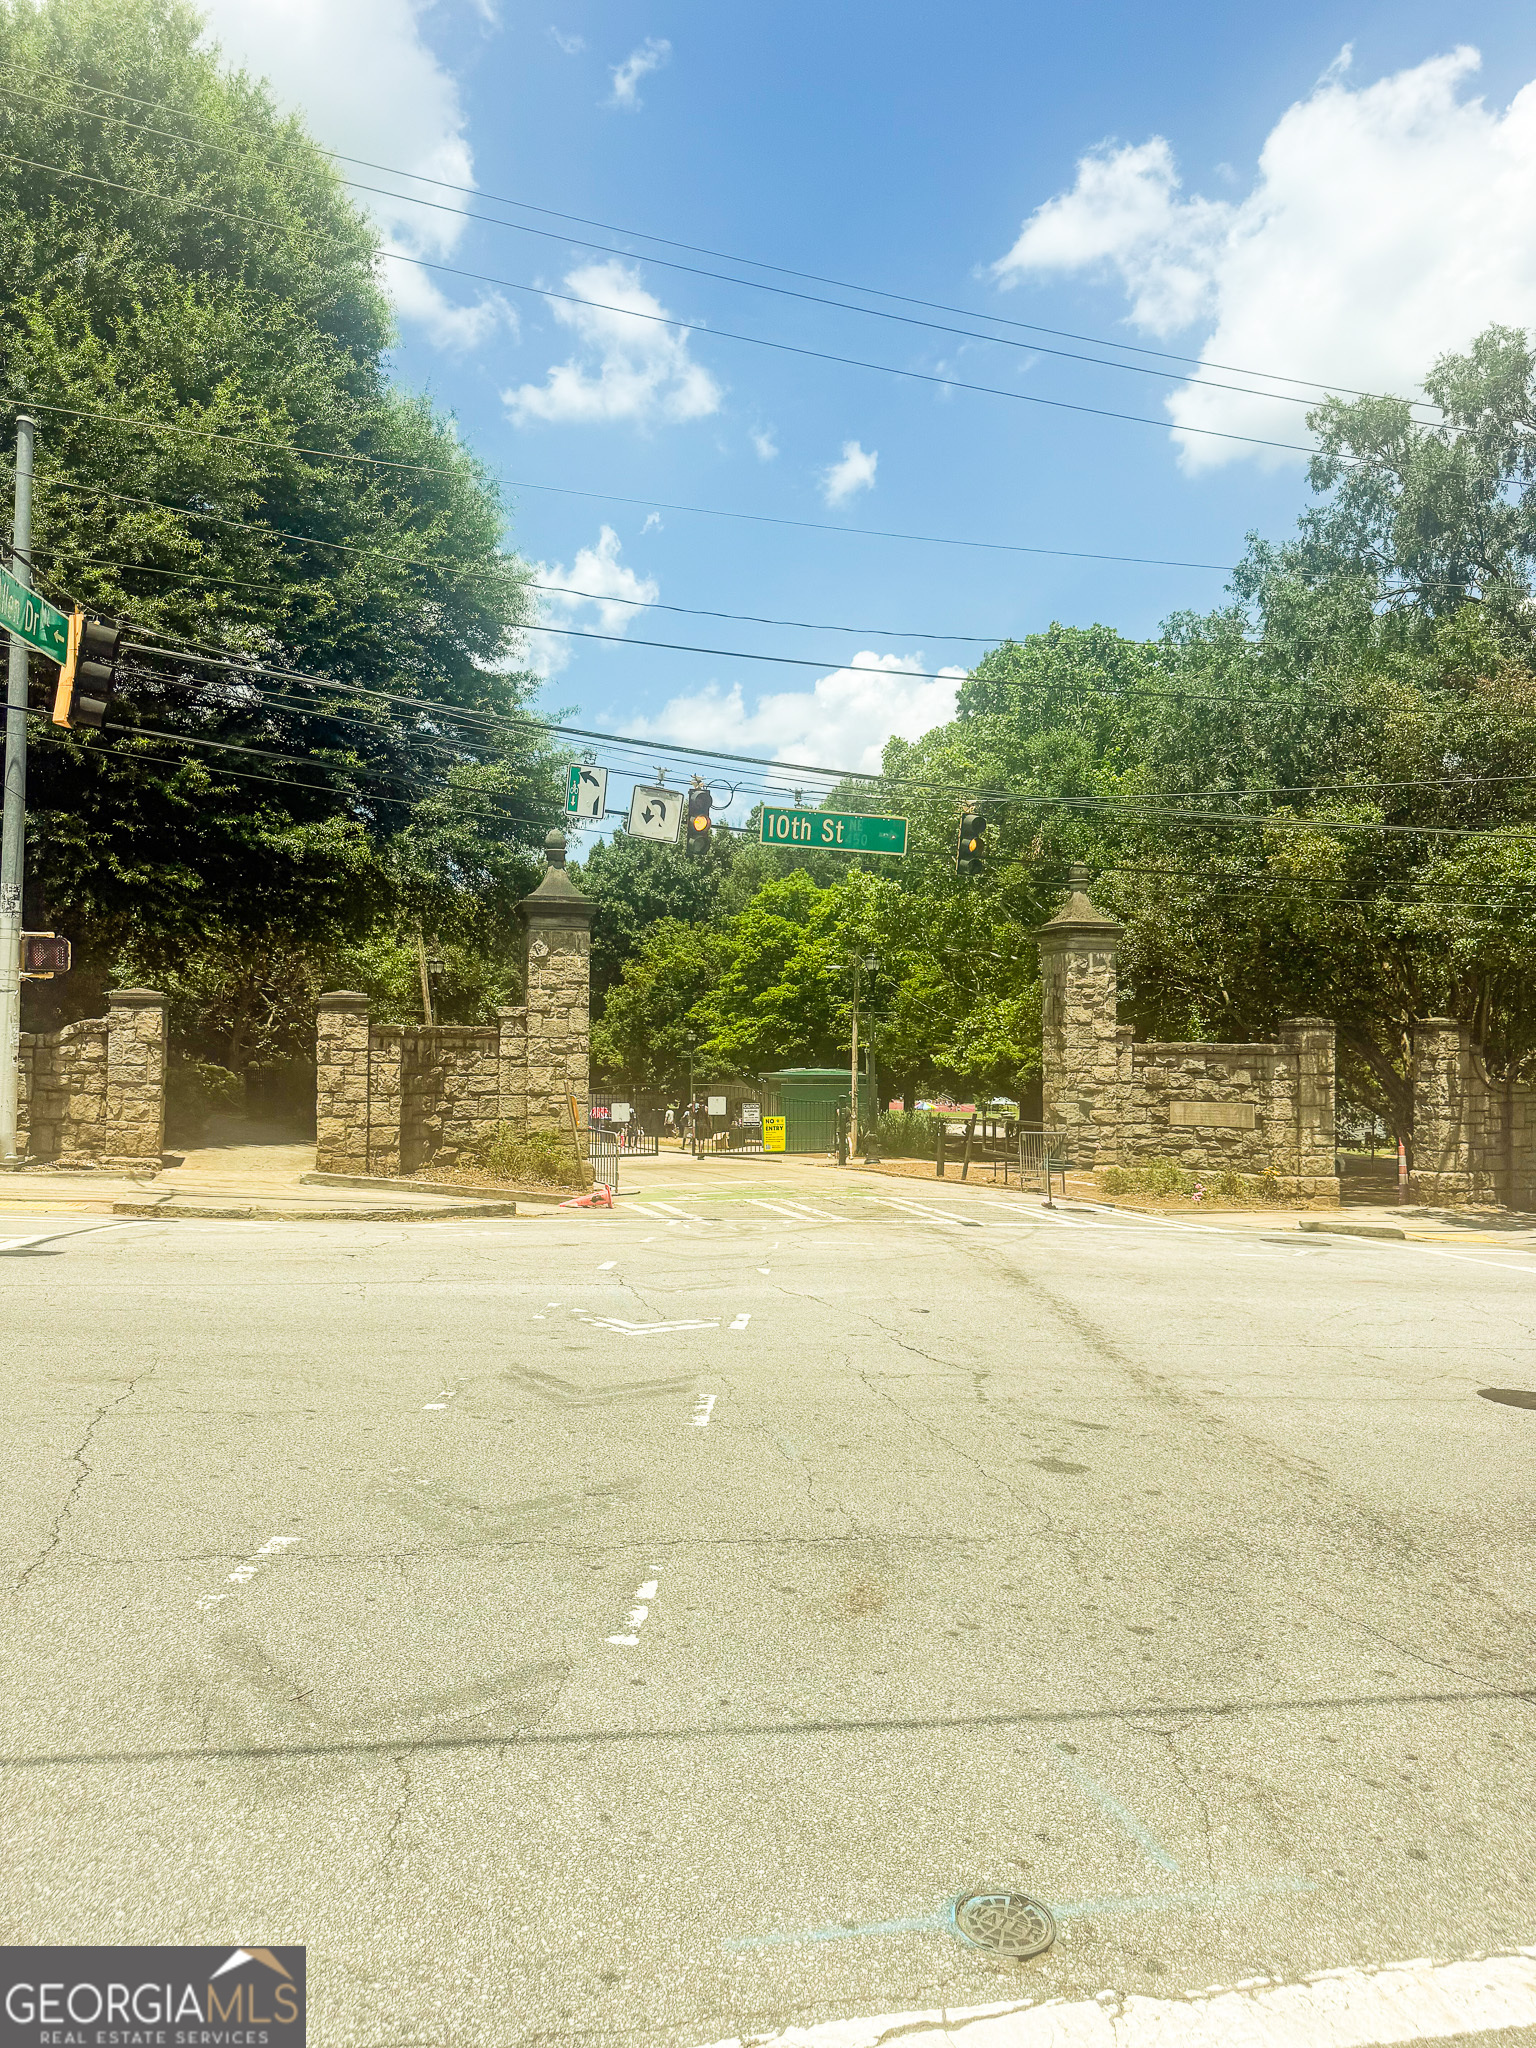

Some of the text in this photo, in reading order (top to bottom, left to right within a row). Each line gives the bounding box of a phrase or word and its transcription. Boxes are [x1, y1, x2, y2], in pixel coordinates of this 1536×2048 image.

[0, 581, 20, 625] llen
[24, 599, 40, 636] Dr
[768, 814, 812, 841] 10th
[821, 818, 845, 844] St
[969, 1907, 1042, 1941] WATER
